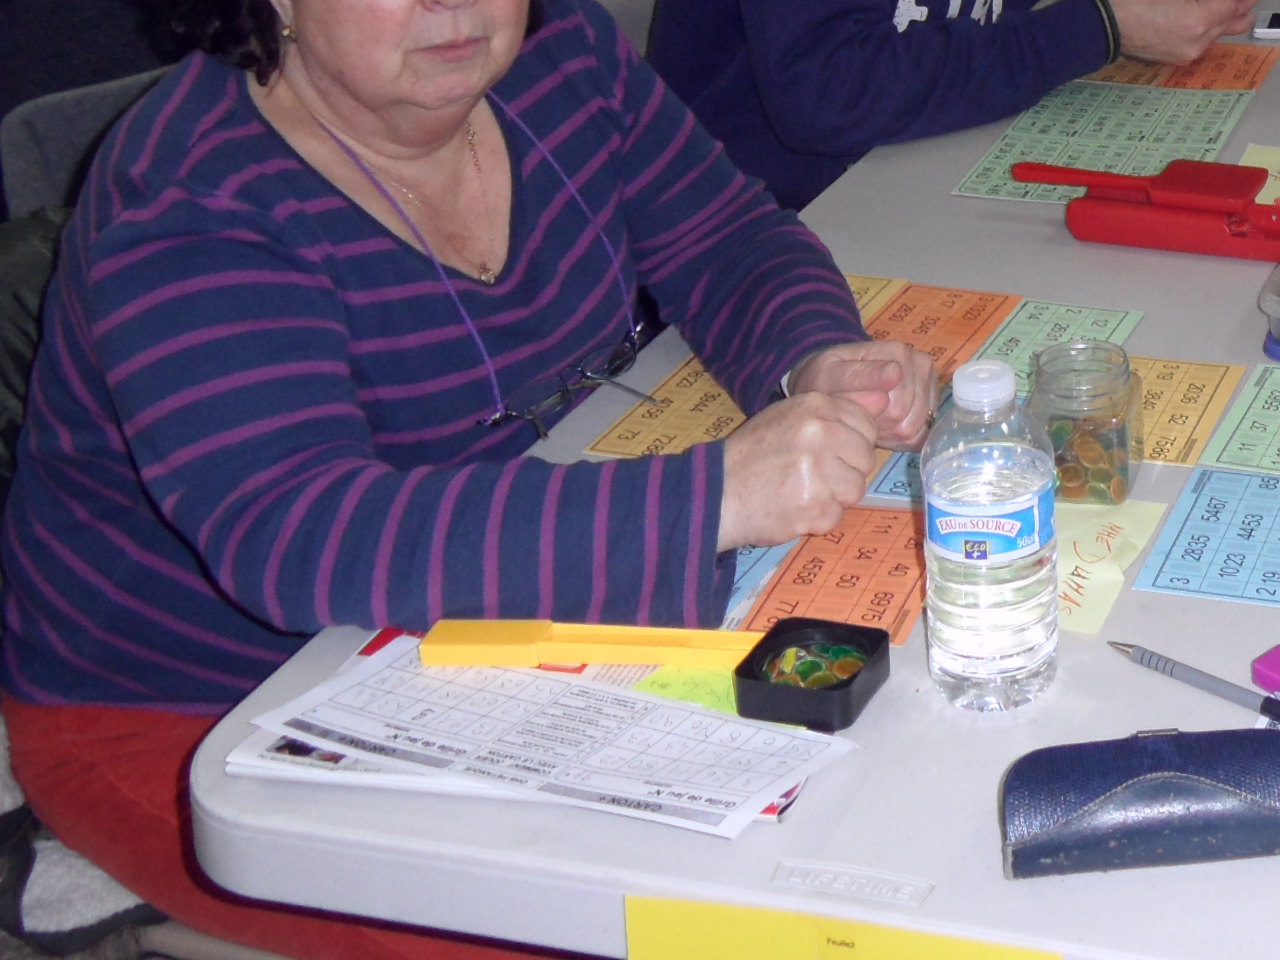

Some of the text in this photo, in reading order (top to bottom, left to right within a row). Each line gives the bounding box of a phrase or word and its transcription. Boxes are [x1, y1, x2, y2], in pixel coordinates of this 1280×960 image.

[1168, 413, 1189, 425] 52
[1156, 435, 1177, 447] 75
[1238, 440, 1258, 452] 11
[1250, 420, 1269, 432] 37
[939, 518, 958, 531] EAU
[969, 519, 1018, 534] SOURCE
[1218, 477, 1279, 578] 10 23 44 53 85
[1169, 496, 1229, 585] 3 28 35 54 67
[856, 546, 877, 560] 34
[802, 556, 825, 571] 45
[887, 563, 911, 577] 40
[792, 570, 817, 586] 58
[836, 573, 861, 589] 50
[870, 591, 895, 607] 69
[1256, 587, 1277, 596] 2
[775, 600, 800, 615] 77
[861, 607, 887, 622] 75
